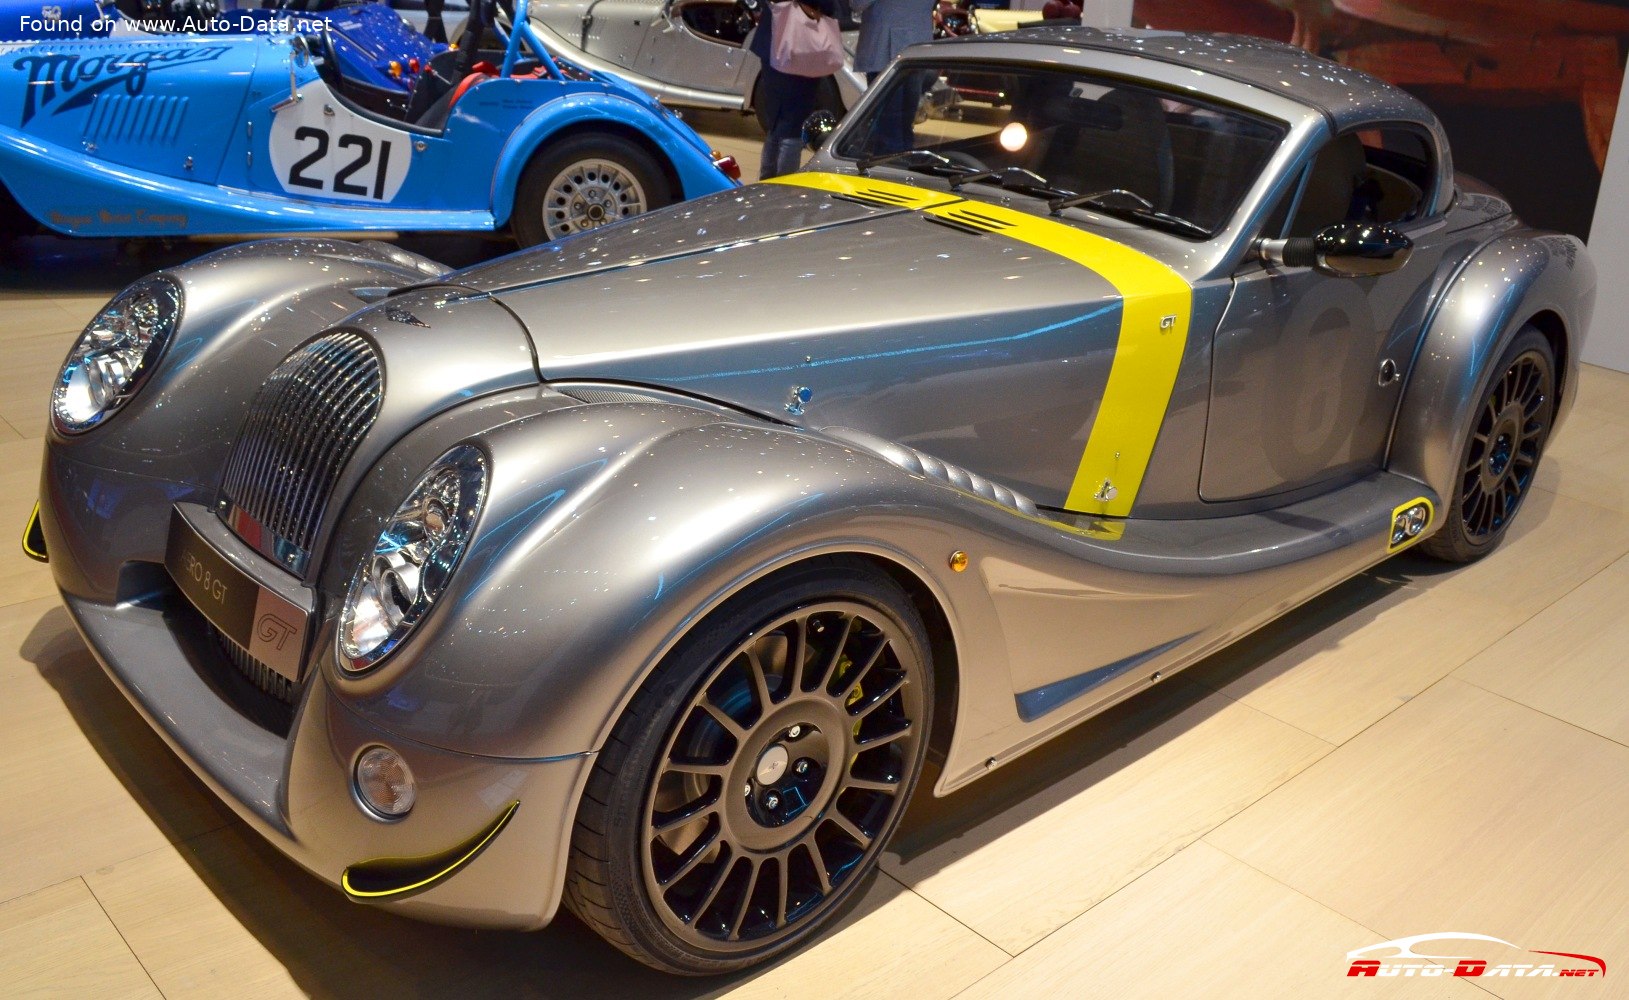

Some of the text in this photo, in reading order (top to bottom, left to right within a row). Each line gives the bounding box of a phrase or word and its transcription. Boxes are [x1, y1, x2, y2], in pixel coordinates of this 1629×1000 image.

[13, 45, 233, 128] Morgan
[288, 126, 392, 200] 221
[1160, 314, 1177, 329] GT
[203, 570, 212, 591] 8
[212, 578, 228, 605] GT
[256, 613, 298, 651] GT
